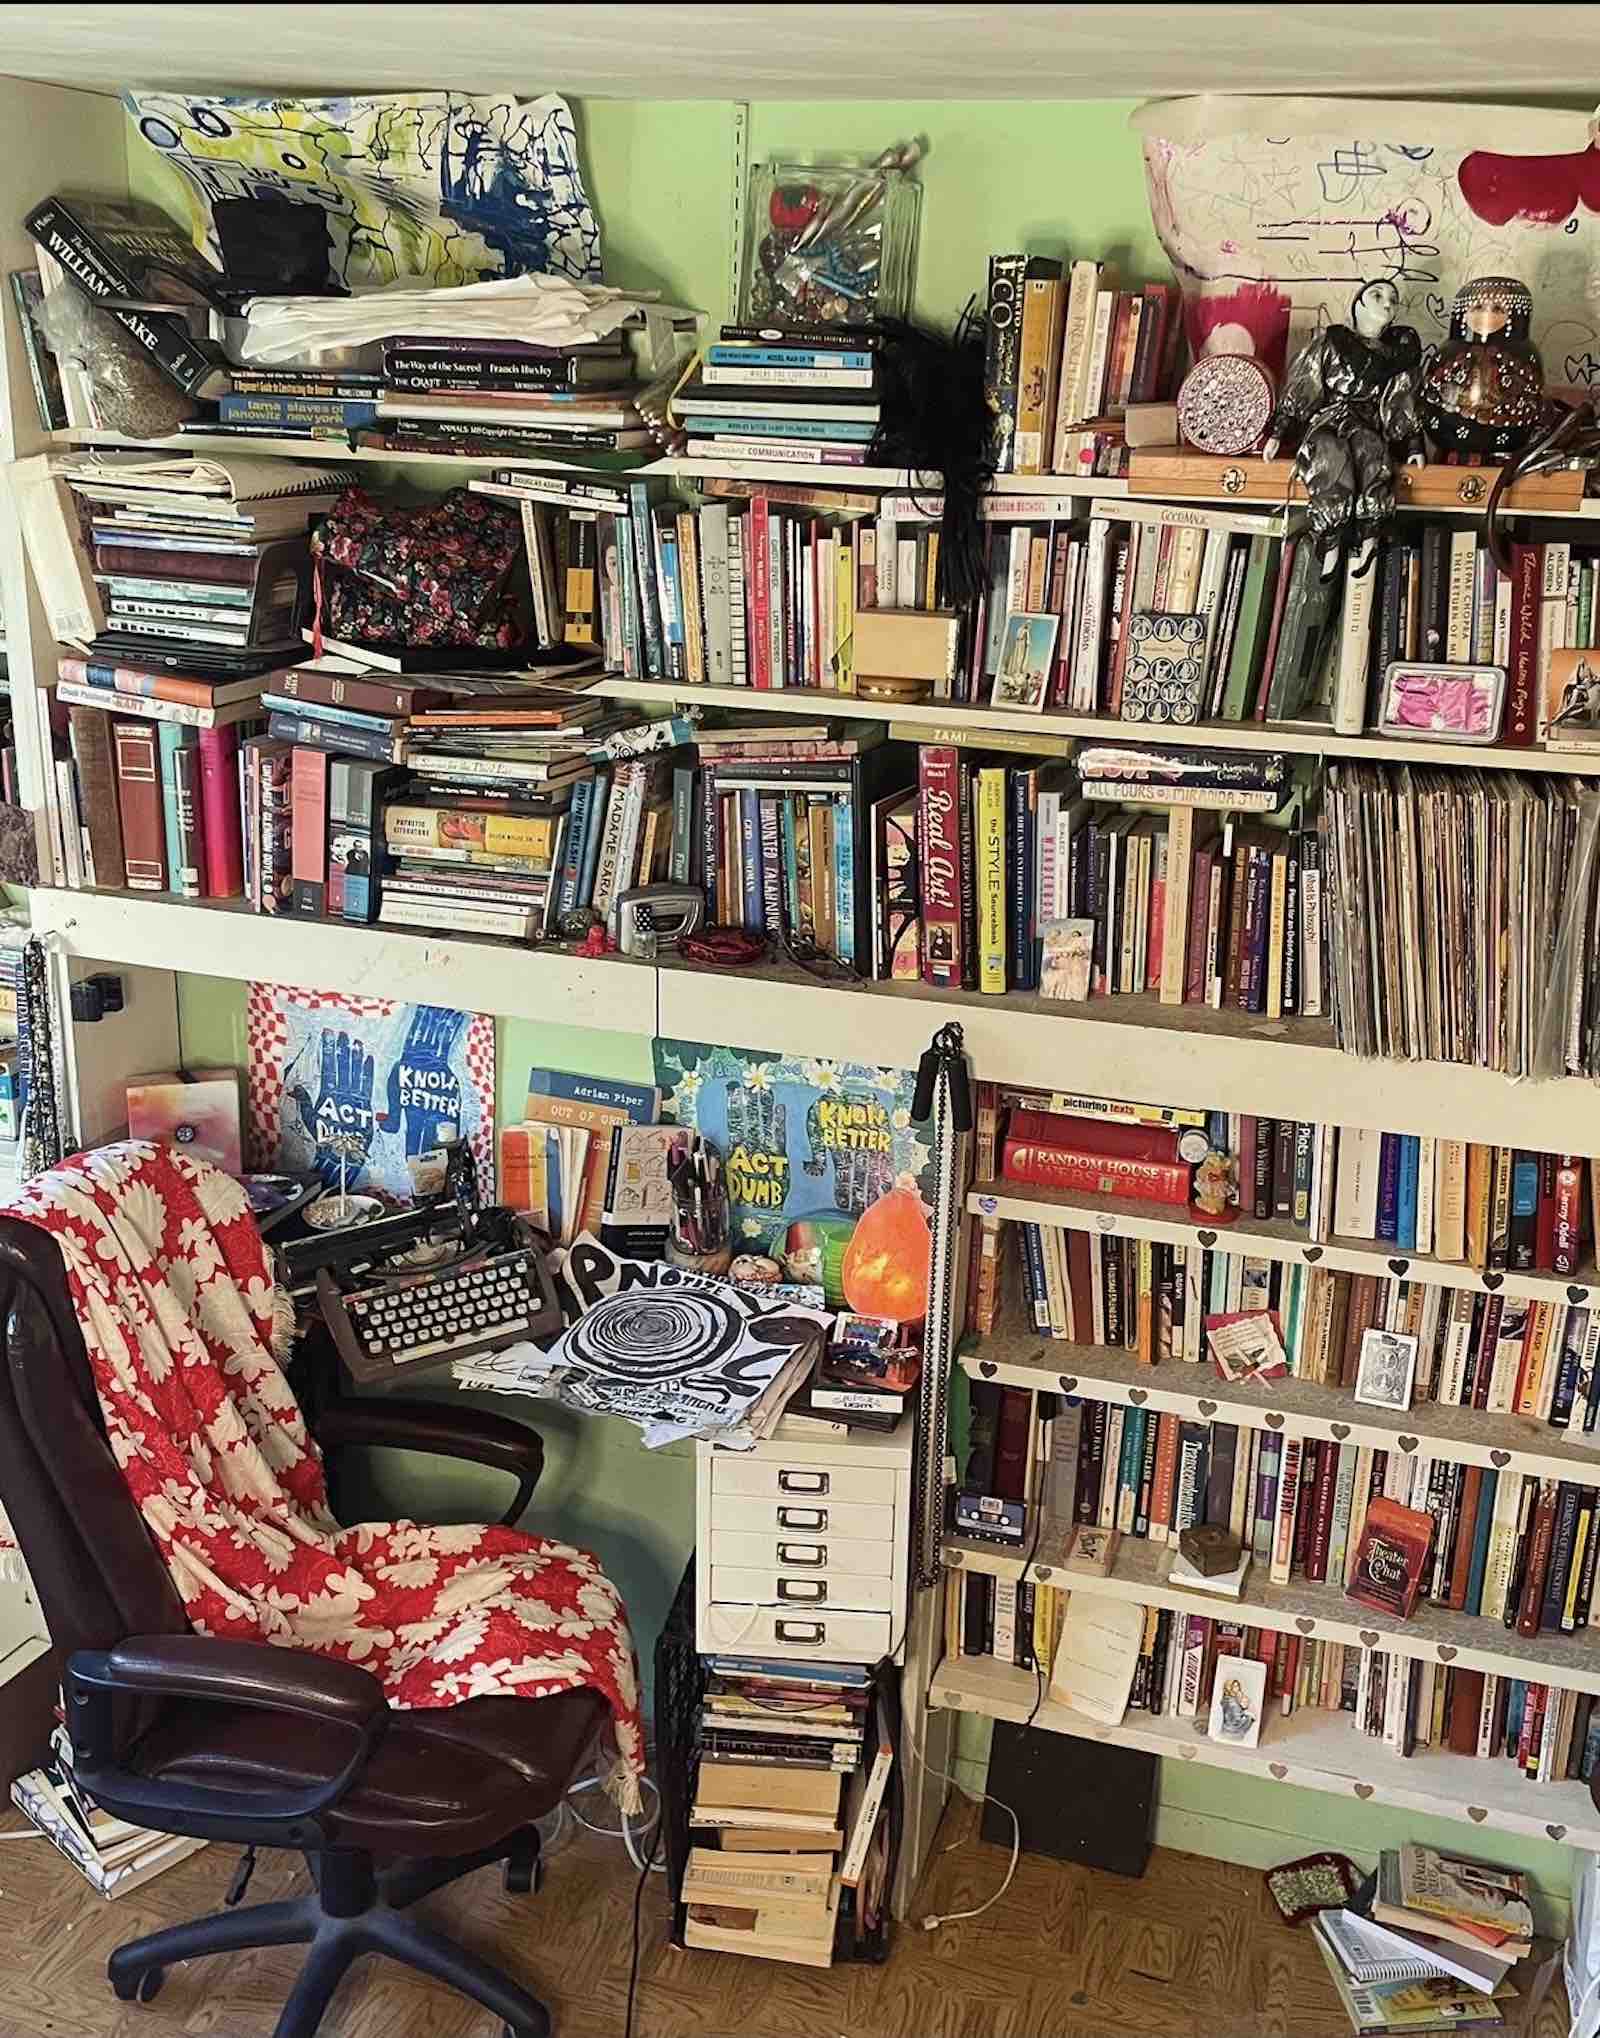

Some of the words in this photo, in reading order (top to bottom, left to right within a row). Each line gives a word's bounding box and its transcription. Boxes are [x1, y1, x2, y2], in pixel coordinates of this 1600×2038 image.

[49, 230, 111, 297] WILLIAM
[990, 257, 1016, 329] ECO
[114, 311, 160, 350] LAKE
[411, 361, 427, 375] Way
[428, 362, 438, 372] of
[439, 362, 452, 373] the
[454, 363, 482, 374] Sacred
[489, 365, 520, 377] Francis
[747, 448, 815, 461] COMMUNICATION
[1116, 549, 1129, 571] TOM
[1453, 552, 1462, 572] THE
[1546, 551, 1555, 593] ALGREN
[1555, 551, 1565, 593] NELSON
[1451, 578, 1461, 620] RETURN
[1462, 595, 1470, 640] CHOPRA
[262, 764, 273, 807] UNTAMED
[1113, 784, 1154, 799] FOURS
[575, 783, 589, 823] IRVINE
[704, 808, 715, 824] the
[927, 787, 955, 851] Real
[605, 789, 625, 857] MADAME
[703, 824, 717, 852] Spirit
[761, 808, 778, 859] HAUNTED
[568, 824, 582, 865] WELSH
[262, 853, 273, 881] DOYLE
[599, 859, 615, 898] SARA
[988, 835, 1001, 892] STYLE
[562, 881, 576, 912] FILTH
[928, 856, 956, 909] Art!
[398, 1065, 459, 1091] KNOW
[316, 1096, 373, 1129] ACT
[398, 1088, 462, 1118] BETTER
[551, 1105, 574, 1120] OUT
[573, 1086, 611, 1102] Adrian
[613, 1092, 646, 1106] Piper
[1063, 1096, 1109, 1113] picturing
[1109, 1103, 1136, 1115] texts
[823, 1128, 892, 1153] BETTER
[1297, 1128, 1313, 1157] Plots
[727, 1145, 788, 1178] ACT
[1036, 1151, 1104, 1171] RANDOM
[1106, 1159, 1160, 1180] HOUSE
[726, 1172, 787, 1209] DUMB
[1558, 1188, 1571, 1221] Jenny
[1558, 1221, 1570, 1250] Odell
[1287, 1441, 1301, 1471] WHY
[1280, 1471, 1298, 1517] POETRY
